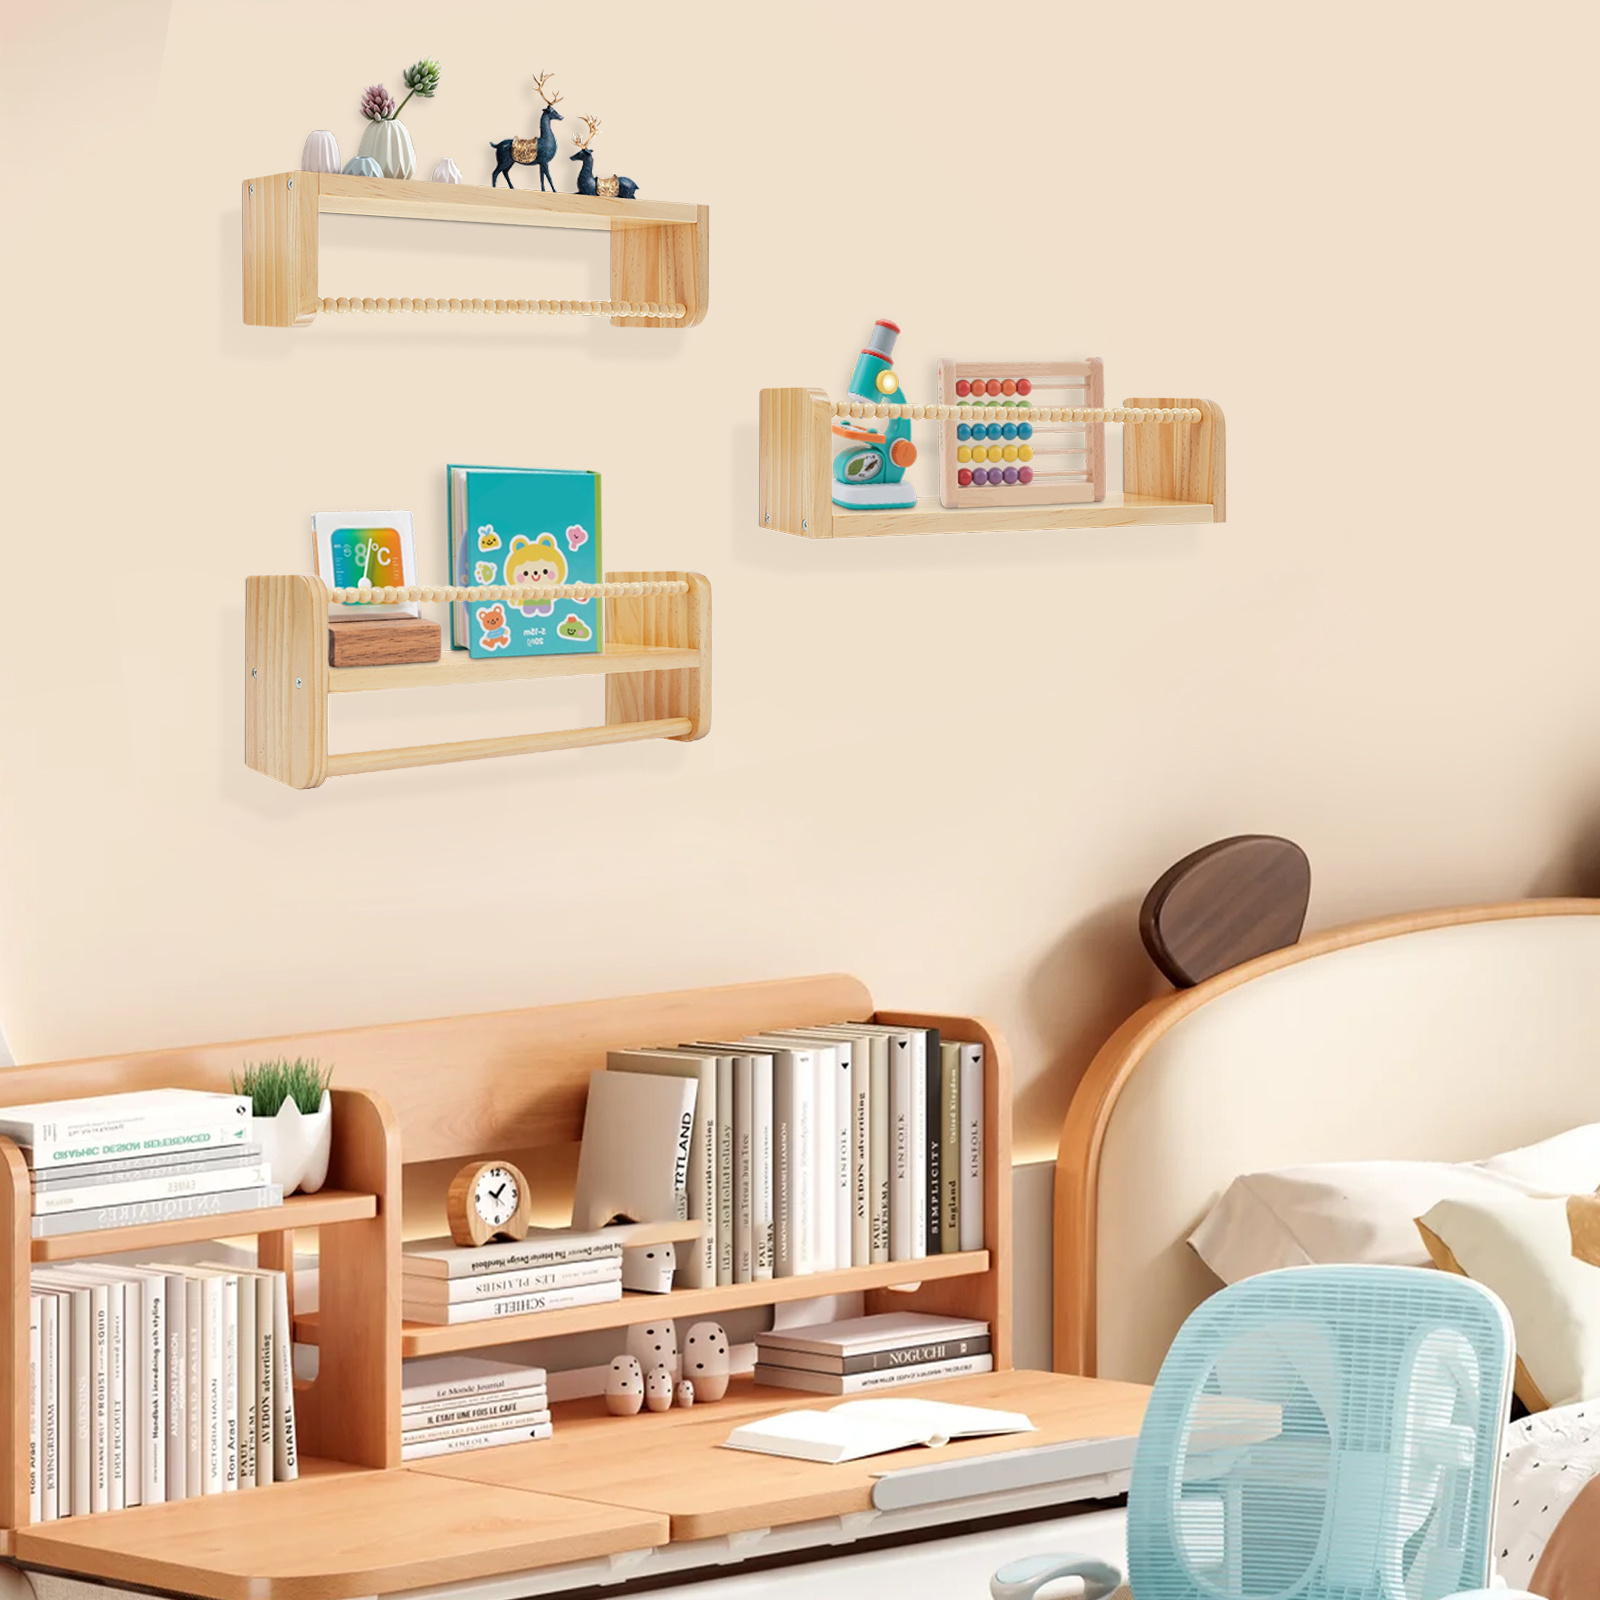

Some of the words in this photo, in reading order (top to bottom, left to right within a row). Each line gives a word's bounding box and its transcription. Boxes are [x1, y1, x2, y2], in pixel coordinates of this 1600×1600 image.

[857, 1092, 866, 1159] advertising
[840, 1128, 848, 1188] KINFOLK
[897, 1113, 905, 1179] KINFOLK
[970, 1119, 979, 1180] KINFOLK
[490, 1168, 501, 1177] 12
[930, 1141, 939, 1235] SIMPLICITY
[475, 1194, 481, 1203] 9
[512, 1189, 518, 1198] 3
[857, 1164, 865, 1219] AVEDON
[947, 1180, 958, 1230] England
[494, 1215, 500, 1224] 6
[872, 1213, 880, 1250] PAUL
[471, 1259, 506, 1272] Handbook
[494, 1297, 546, 1315] SCHIELE
[97, 1310, 105, 1346] SQUID
[261, 1334, 272, 1392] advertising
[889, 1344, 946, 1365] NOGUCHI
[448, 1386, 475, 1395] Monde
[477, 1380, 505, 1391] Journal
[227, 1419, 236, 1450] Arad
[261, 1396, 271, 1445] AVEDON
[284, 1405, 295, 1467] CHANEL
[227, 1454, 236, 1482] Ron
[240, 1440, 248, 1477] PAUL
